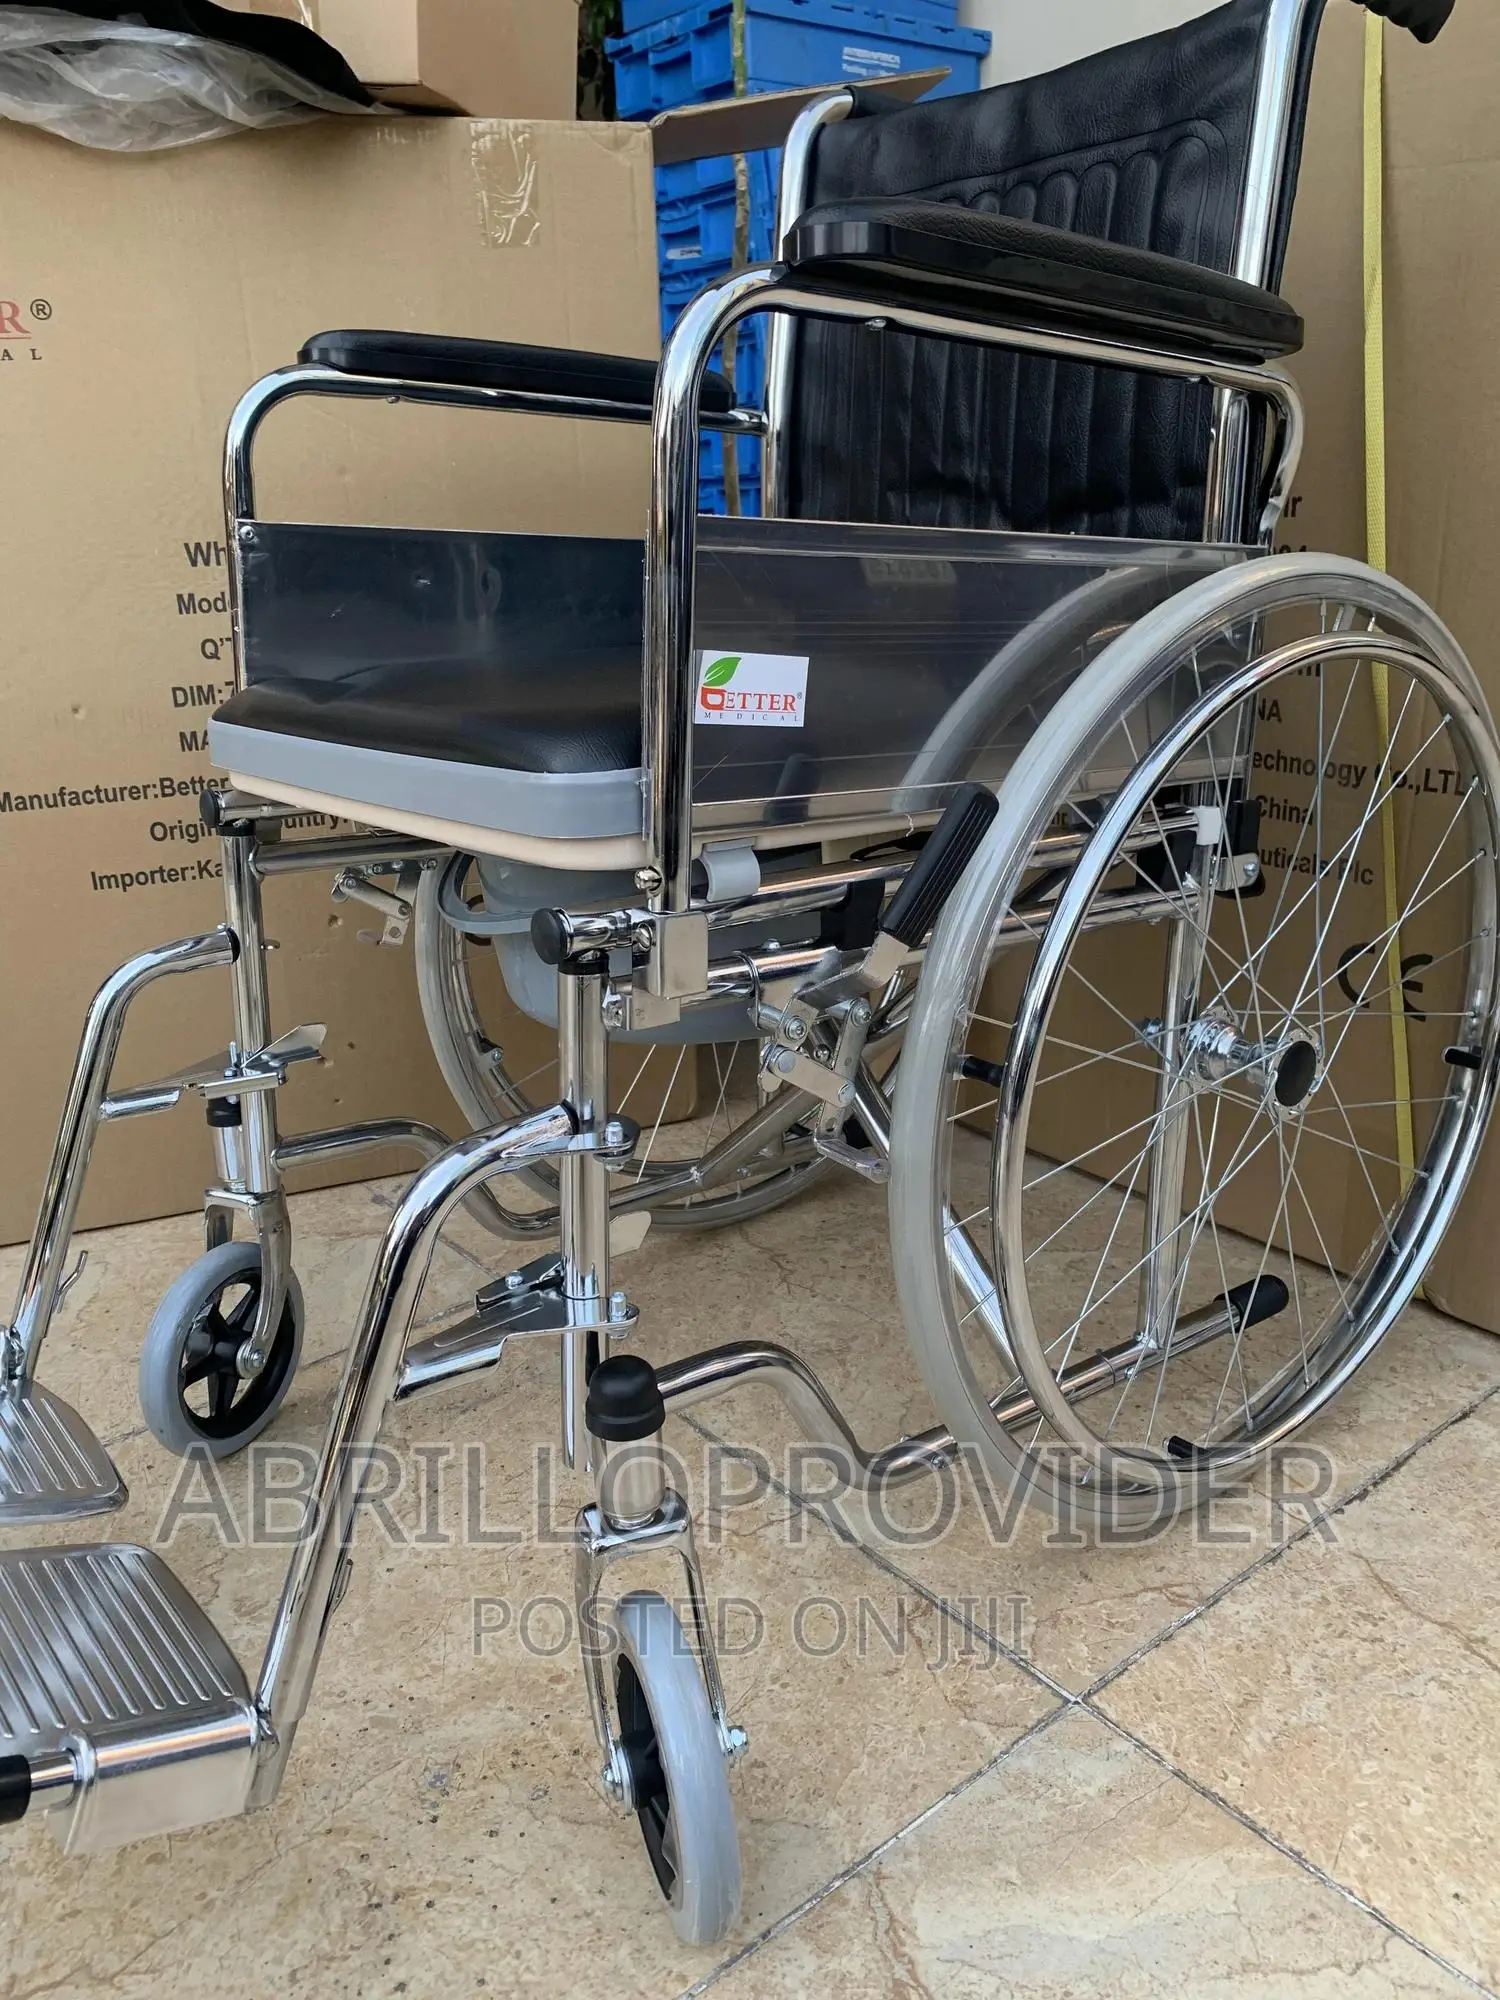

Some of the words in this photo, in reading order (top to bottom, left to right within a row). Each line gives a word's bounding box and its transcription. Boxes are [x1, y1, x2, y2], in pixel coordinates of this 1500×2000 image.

[176, 591, 230, 615] Mod
[704, 711, 800, 722] MEDICAL
[1252, 750, 1367, 789] echnoogy
[1257, 794, 1314, 826] China
